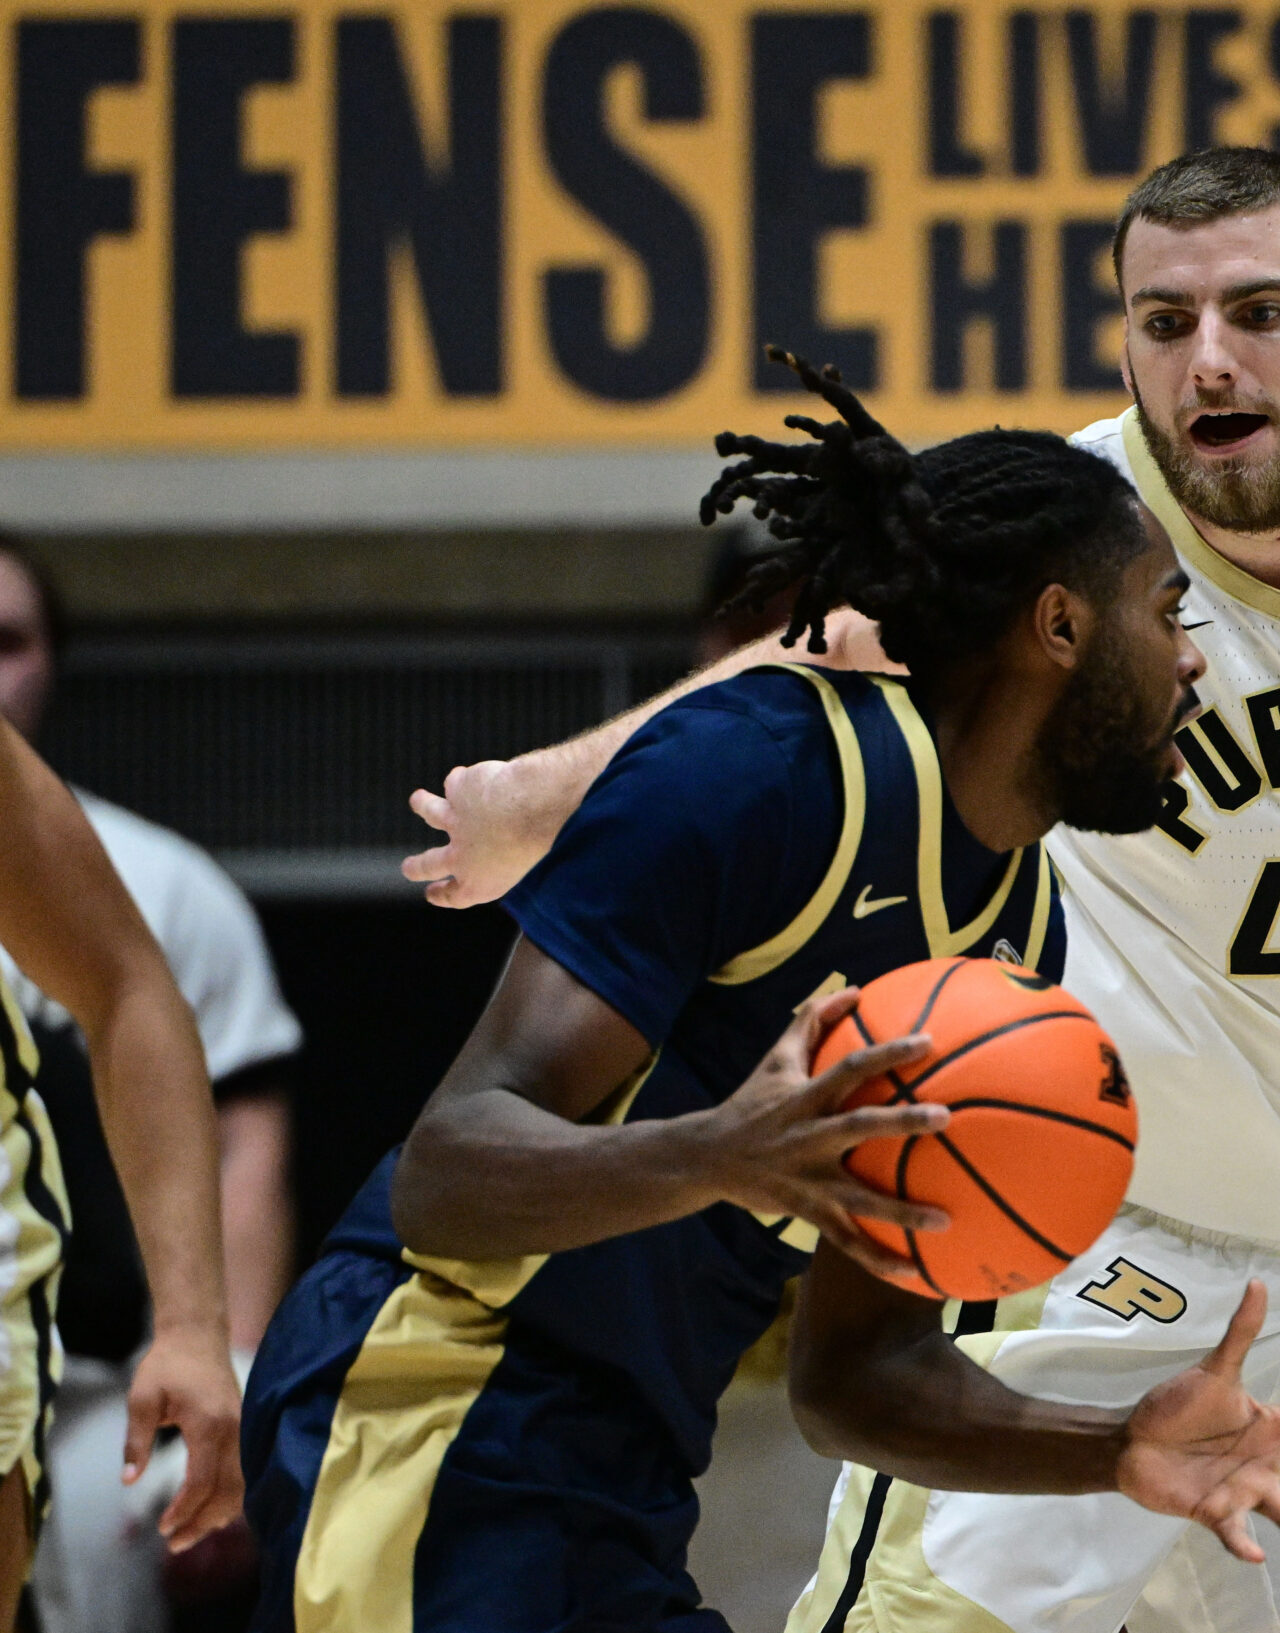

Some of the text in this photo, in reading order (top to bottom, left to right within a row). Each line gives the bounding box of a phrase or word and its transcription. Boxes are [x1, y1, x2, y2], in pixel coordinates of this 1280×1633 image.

[12, 8, 882, 406] FENSE
[926, 216, 1130, 394] HE
[1078, 1256, 1187, 1325] P
